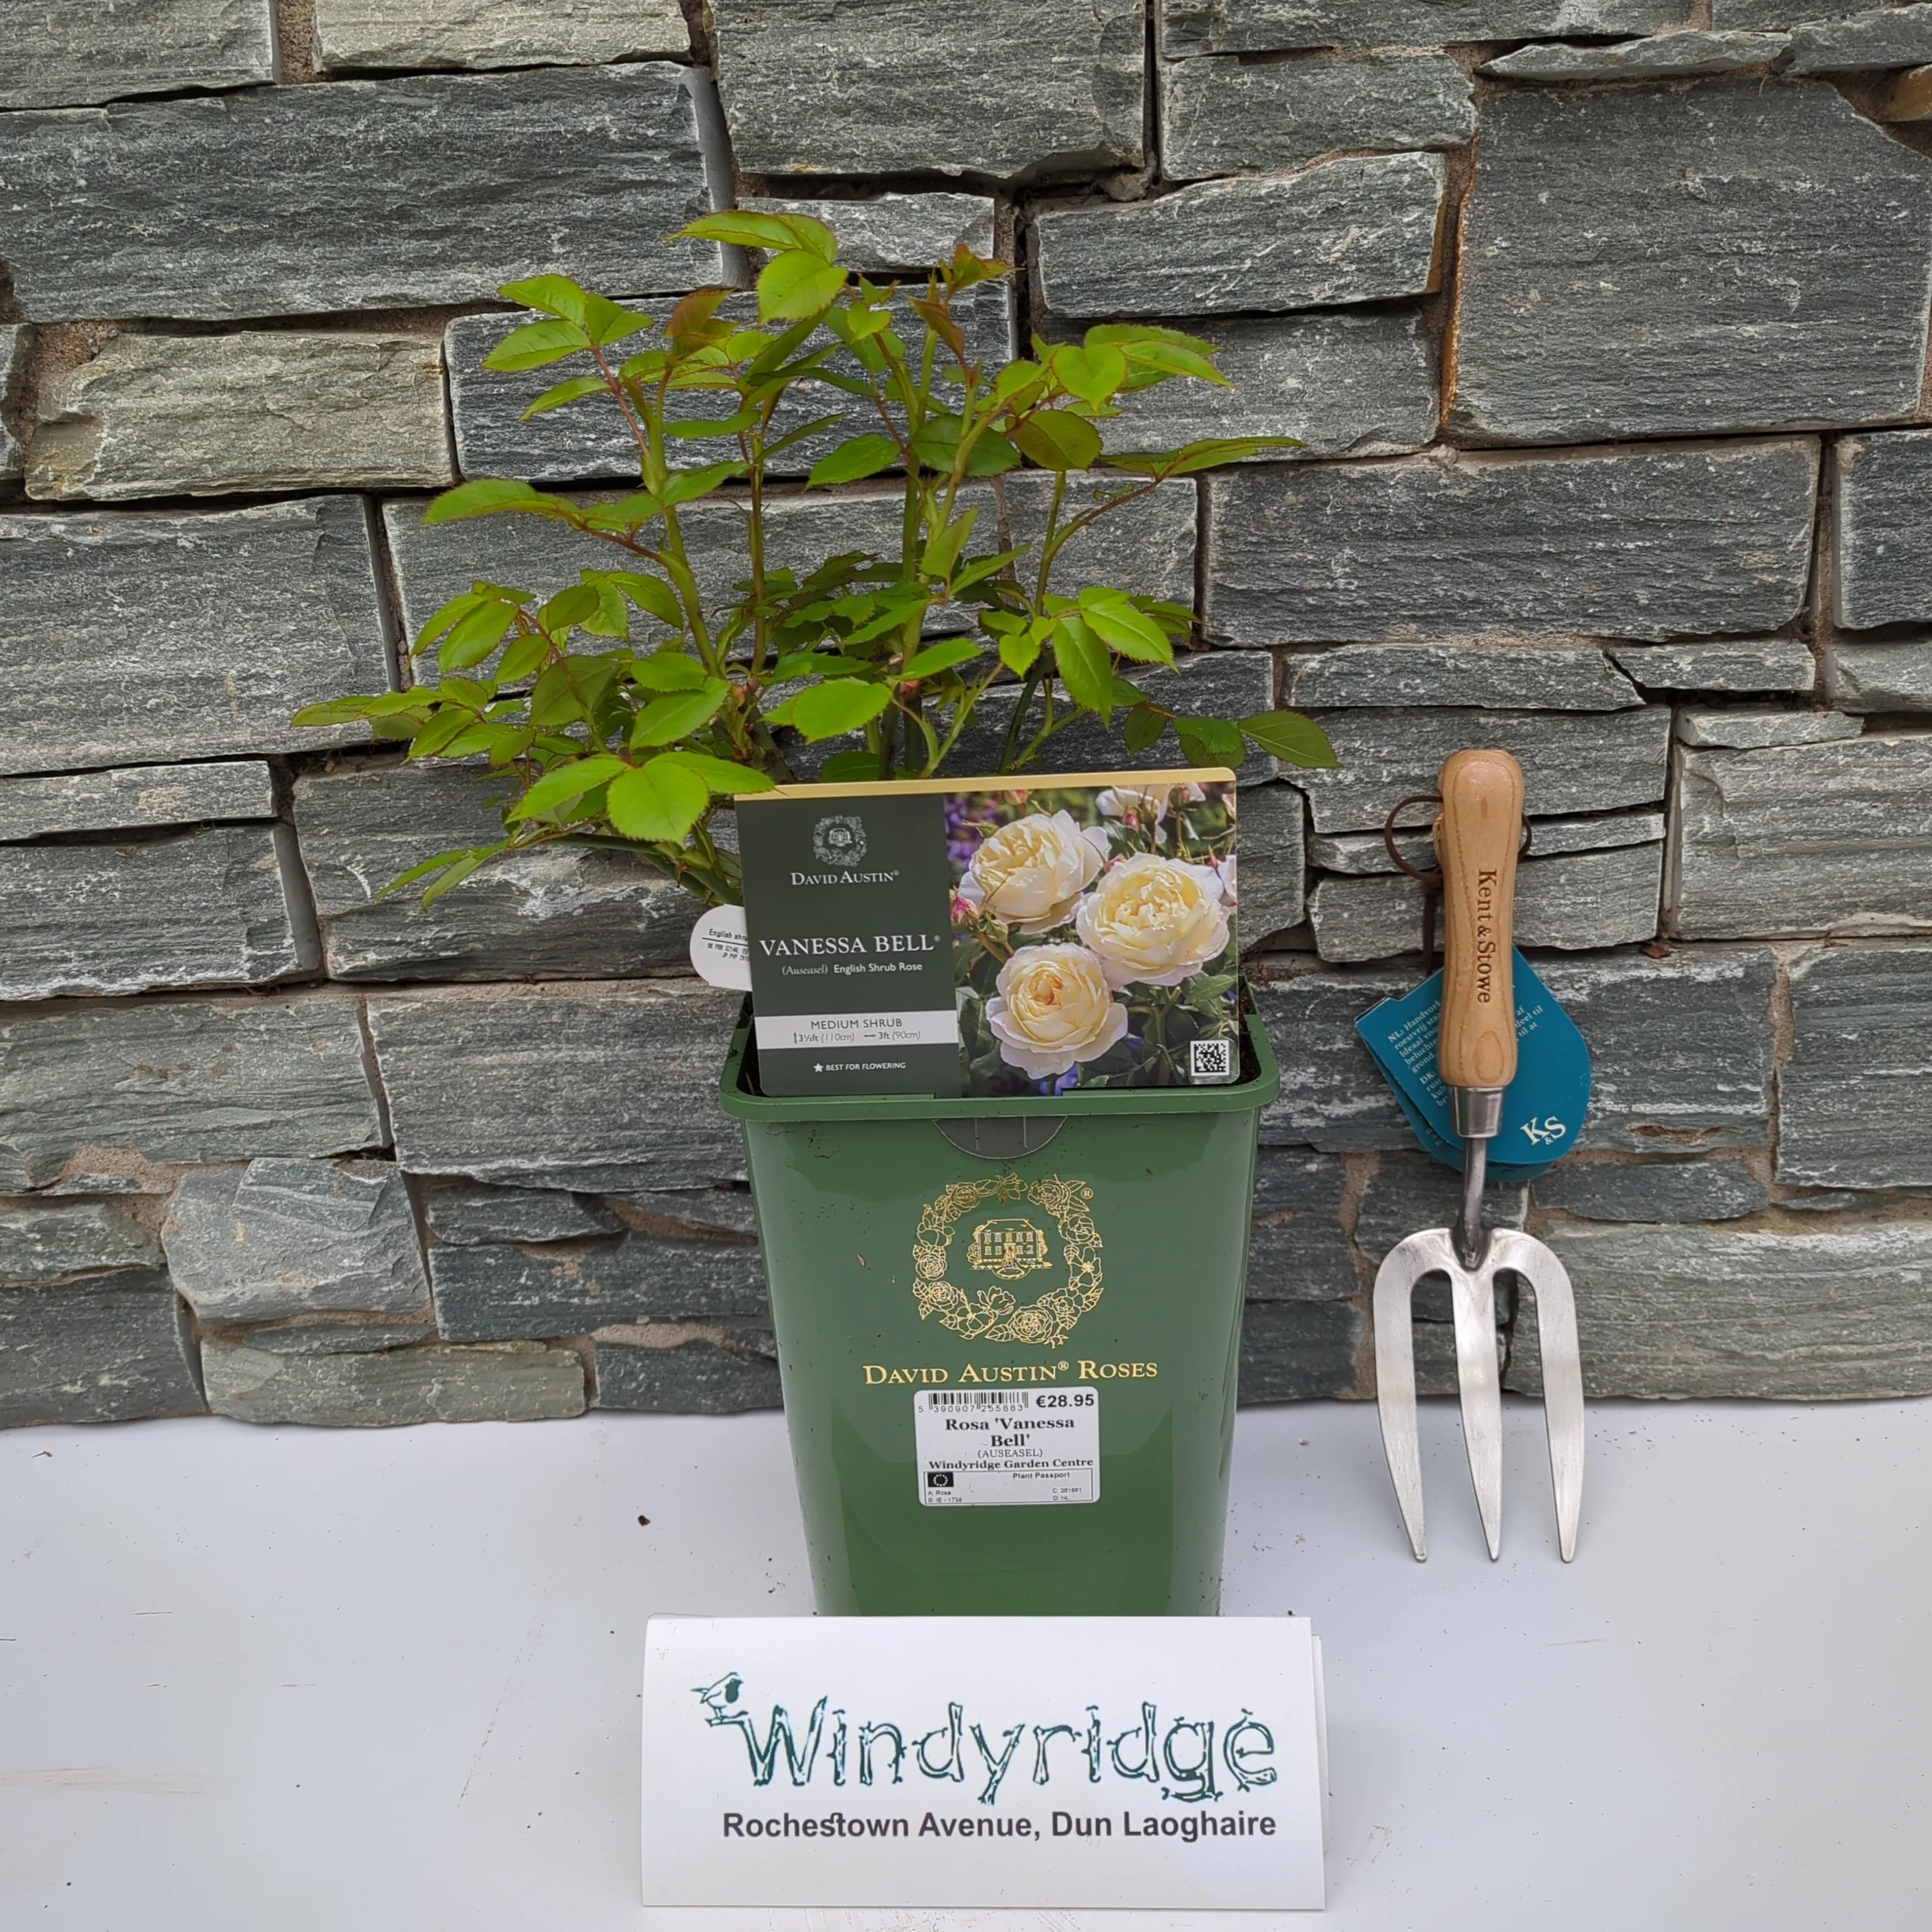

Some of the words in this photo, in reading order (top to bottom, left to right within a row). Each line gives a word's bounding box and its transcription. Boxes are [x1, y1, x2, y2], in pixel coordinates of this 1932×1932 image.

[791, 872, 838, 886] DAVID
[1477, 869, 1497, 922] Kent
[709, 928, 732, 938] English
[1477, 925, 1491, 938] &
[759, 937, 867, 957] VANESSA
[782, 964, 828, 975] (Auseasel)
[834, 964, 865, 975] English
[869, 963, 896, 972] Shrub
[899, 962, 923, 971] Rose
[1477, 941, 1496, 1004] Stowe
[811, 1019, 859, 1030] MEDIUM
[863, 1018, 902, 1029] SHRUB
[821, 1033, 855, 1043] (110cm)
[879, 1031, 890, 1040] 3ft
[892, 1030, 921, 1041] (90cm)
[1388, 1030, 1404, 1043] NL:
[1399, 1036, 1424, 1058] Ideaal
[862, 1365, 949, 1384] DAVID
[1077, 1360, 1158, 1379] ROSES
[933, 1405, 975, 1413] 390907
[981, 1404, 1023, 1413] 255883
[1036, 1394, 1094, 1408] €28.95
[945, 1418, 989, 1431] Rosa
[995, 1417, 1075, 1430] 'Vanessa
[991, 1434, 1030, 1447] Bell'
[977, 1448, 1043, 1460] (AUSEASEL)
[928, 1460, 1001, 1470] Windyridge
[1004, 1459, 1049, 1468] Garden
[1052, 1458, 1094, 1467] Centre
[1035, 1472, 1070, 1480] Passport
[704, 1695, 1278, 1805] Windyridge
[723, 1811, 909, 1838] Rochestown
[917, 1813, 1040, 1842] Avenue,
[1052, 1813, 1112, 1838] Dun
[1124, 1811, 1277, 1843] Laoghaire
